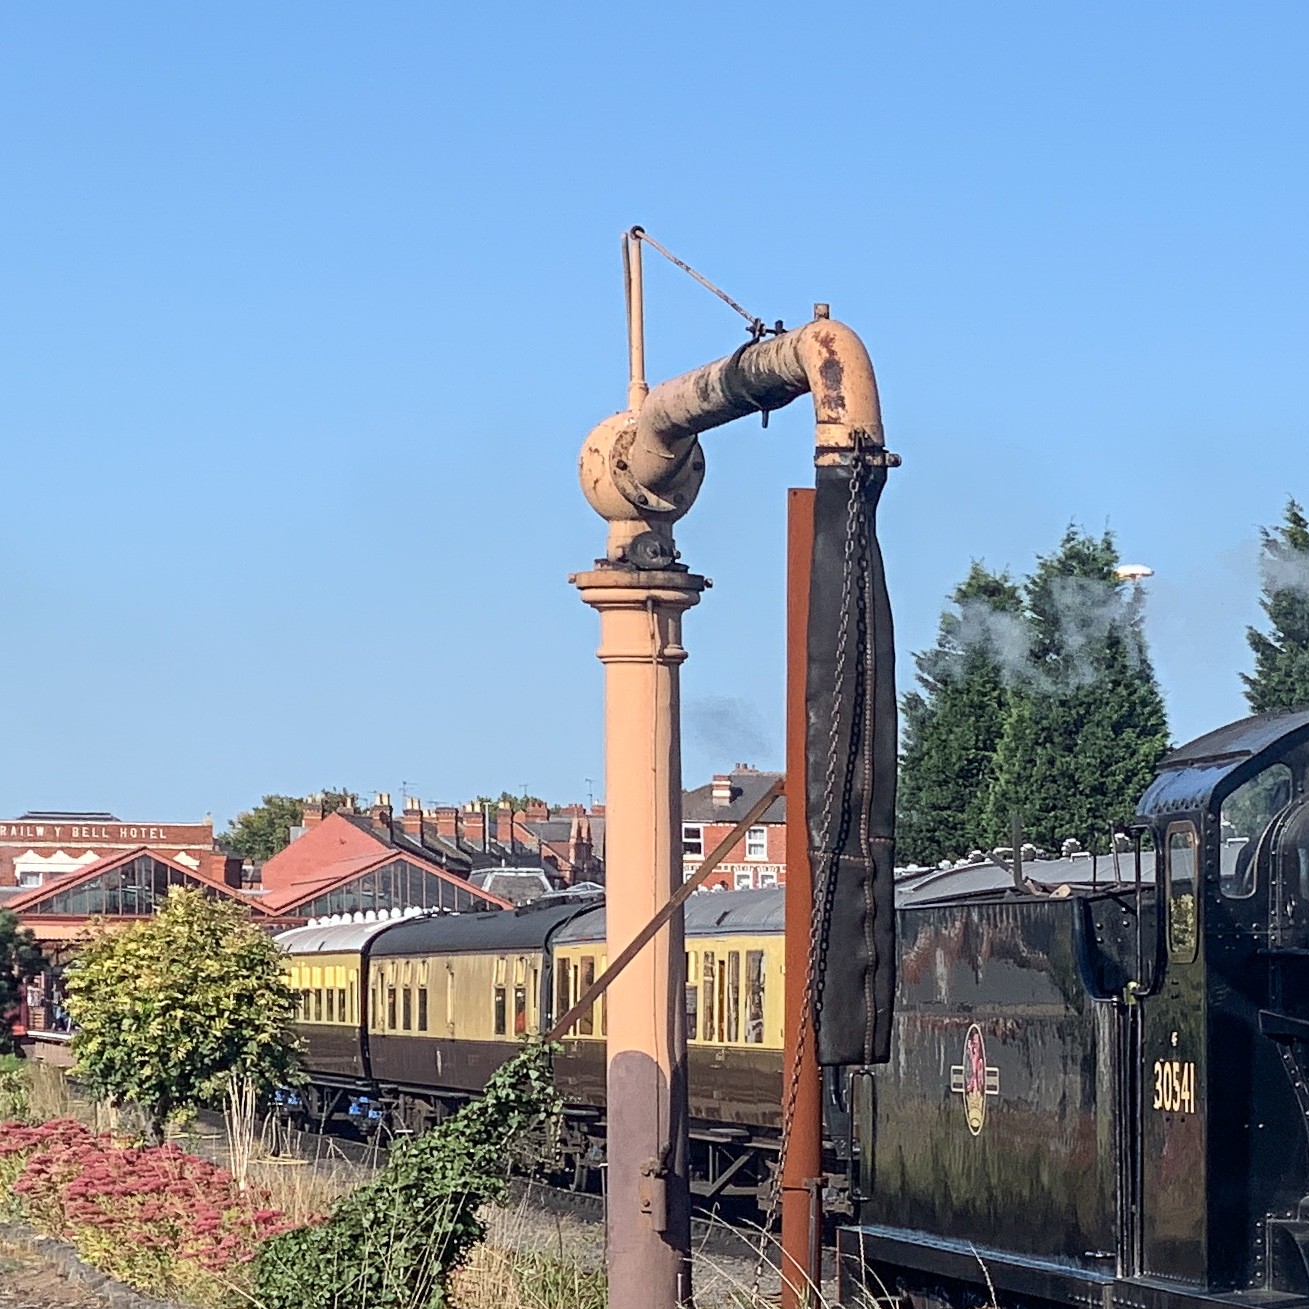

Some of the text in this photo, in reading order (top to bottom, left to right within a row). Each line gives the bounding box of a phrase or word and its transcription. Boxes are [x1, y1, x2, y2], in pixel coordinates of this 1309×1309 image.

[72, 827, 109, 838] BELL
[120, 827, 167, 839] HOTEL
[1153, 1061, 1195, 1114] 30541
